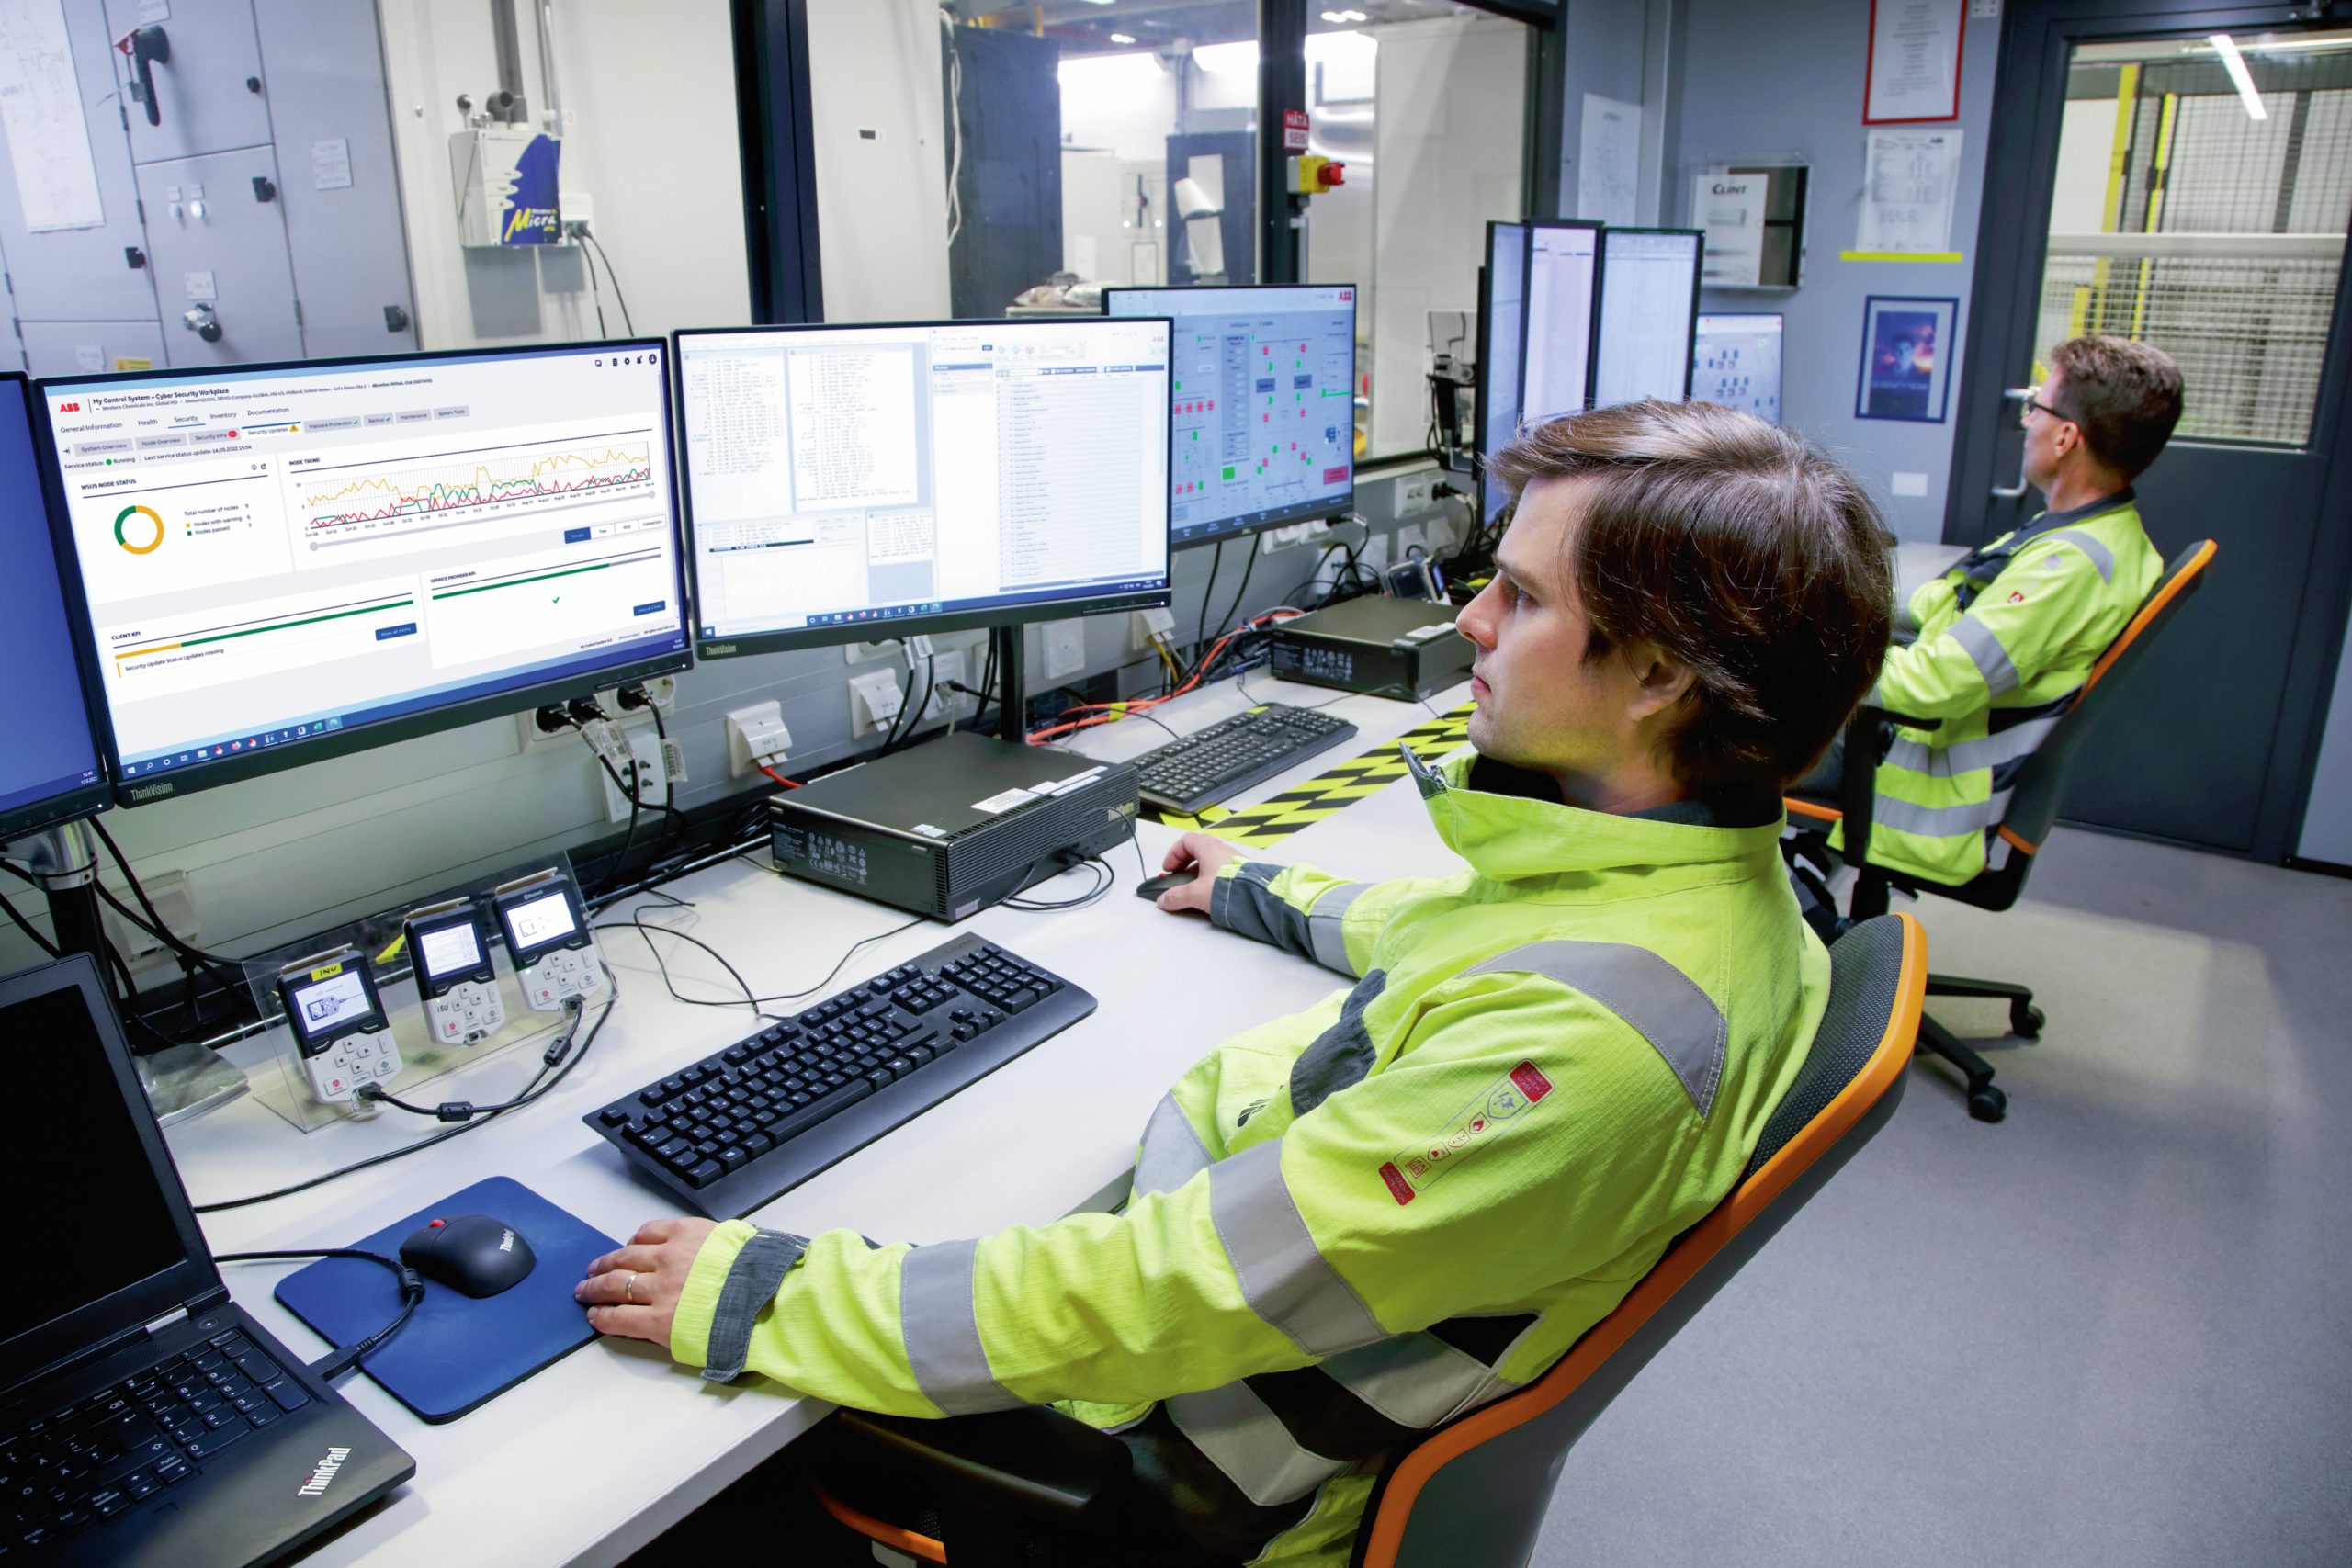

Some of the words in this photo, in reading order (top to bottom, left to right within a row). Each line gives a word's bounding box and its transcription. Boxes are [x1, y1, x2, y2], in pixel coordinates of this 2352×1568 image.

[504, 208, 556, 242] Micra
[1339, 291, 1352, 301] ABB
[156, 393, 173, 401] Cyber
[174, 390, 198, 399] Security
[60, 403, 80, 413] ABB
[85, 423, 123, 431] Information
[247, 407, 289, 416] Documentation
[706, 644, 736, 655] ThinkVision
[130, 782, 173, 801] ThinkVision
[499, 1228, 514, 1252] Think
[268, 1380, 283, 1390] Enter
[297, 1446, 352, 1498] ThinkPad
